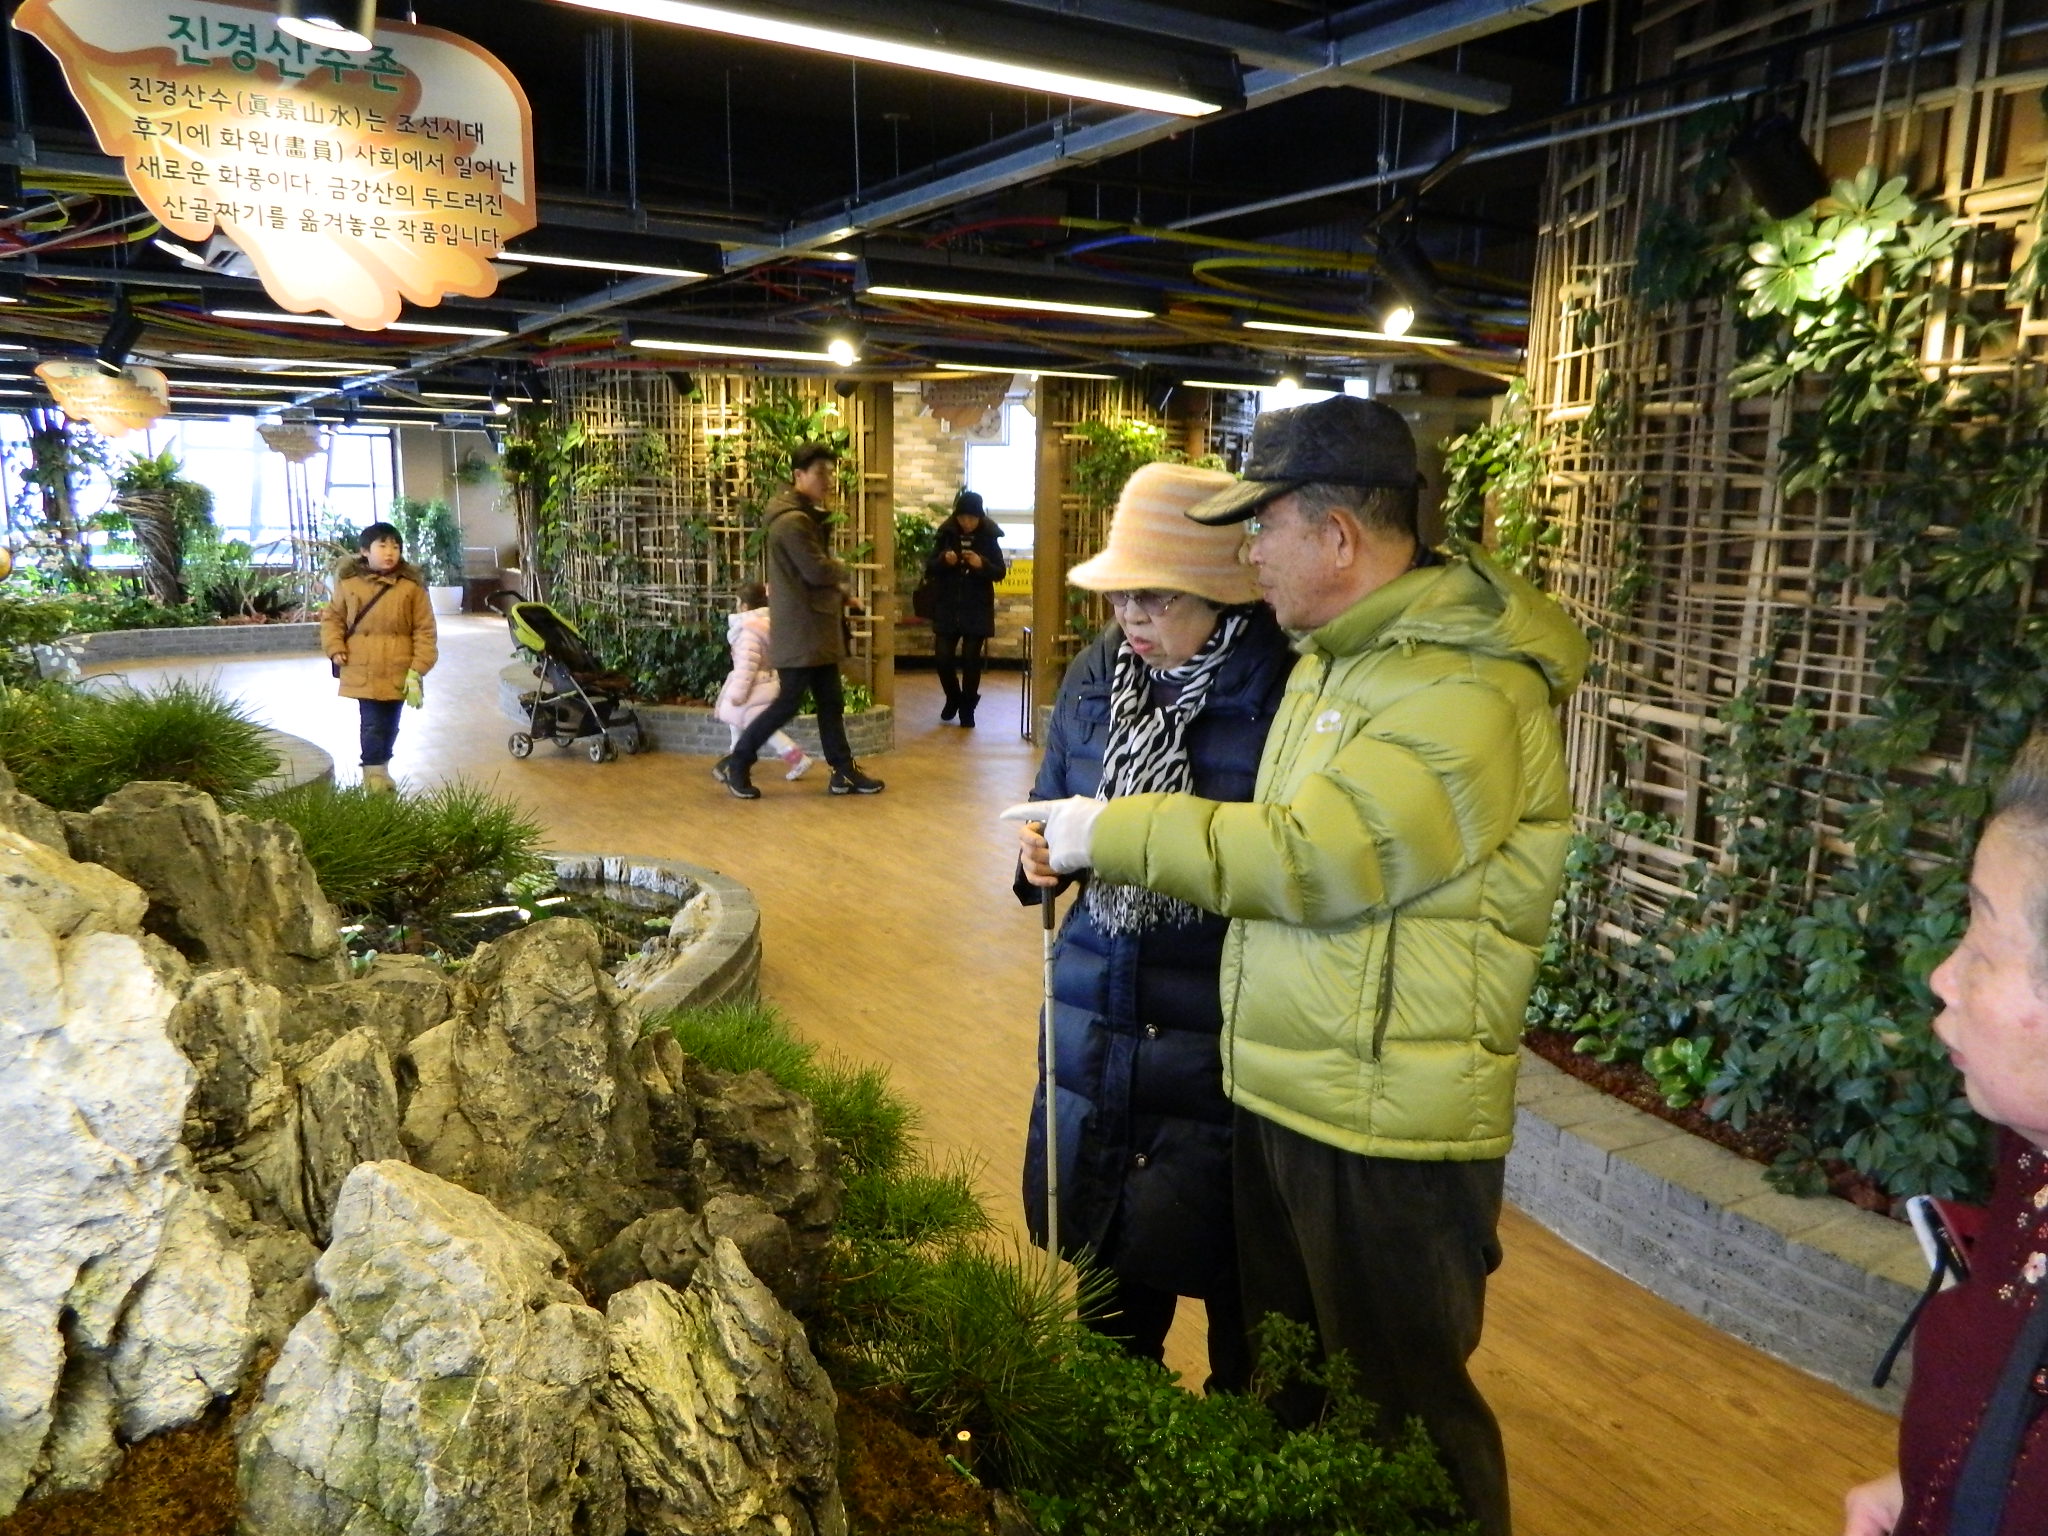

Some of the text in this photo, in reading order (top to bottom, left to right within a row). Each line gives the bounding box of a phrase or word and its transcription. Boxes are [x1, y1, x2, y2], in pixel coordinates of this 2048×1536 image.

[168, 14, 406, 92] 진경산수존
[132, 116, 211, 148] 후기에
[354, 144, 445, 176] 사회에서
[453, 156, 517, 185] 일어난
[396, 114, 485, 145] 조선시대
[135, 156, 503, 217] 새로운 화풍이다. 금강산의 두드러진
[162, 195, 506, 250] 산골짜기를 옮겨놓은 작품입니다.
